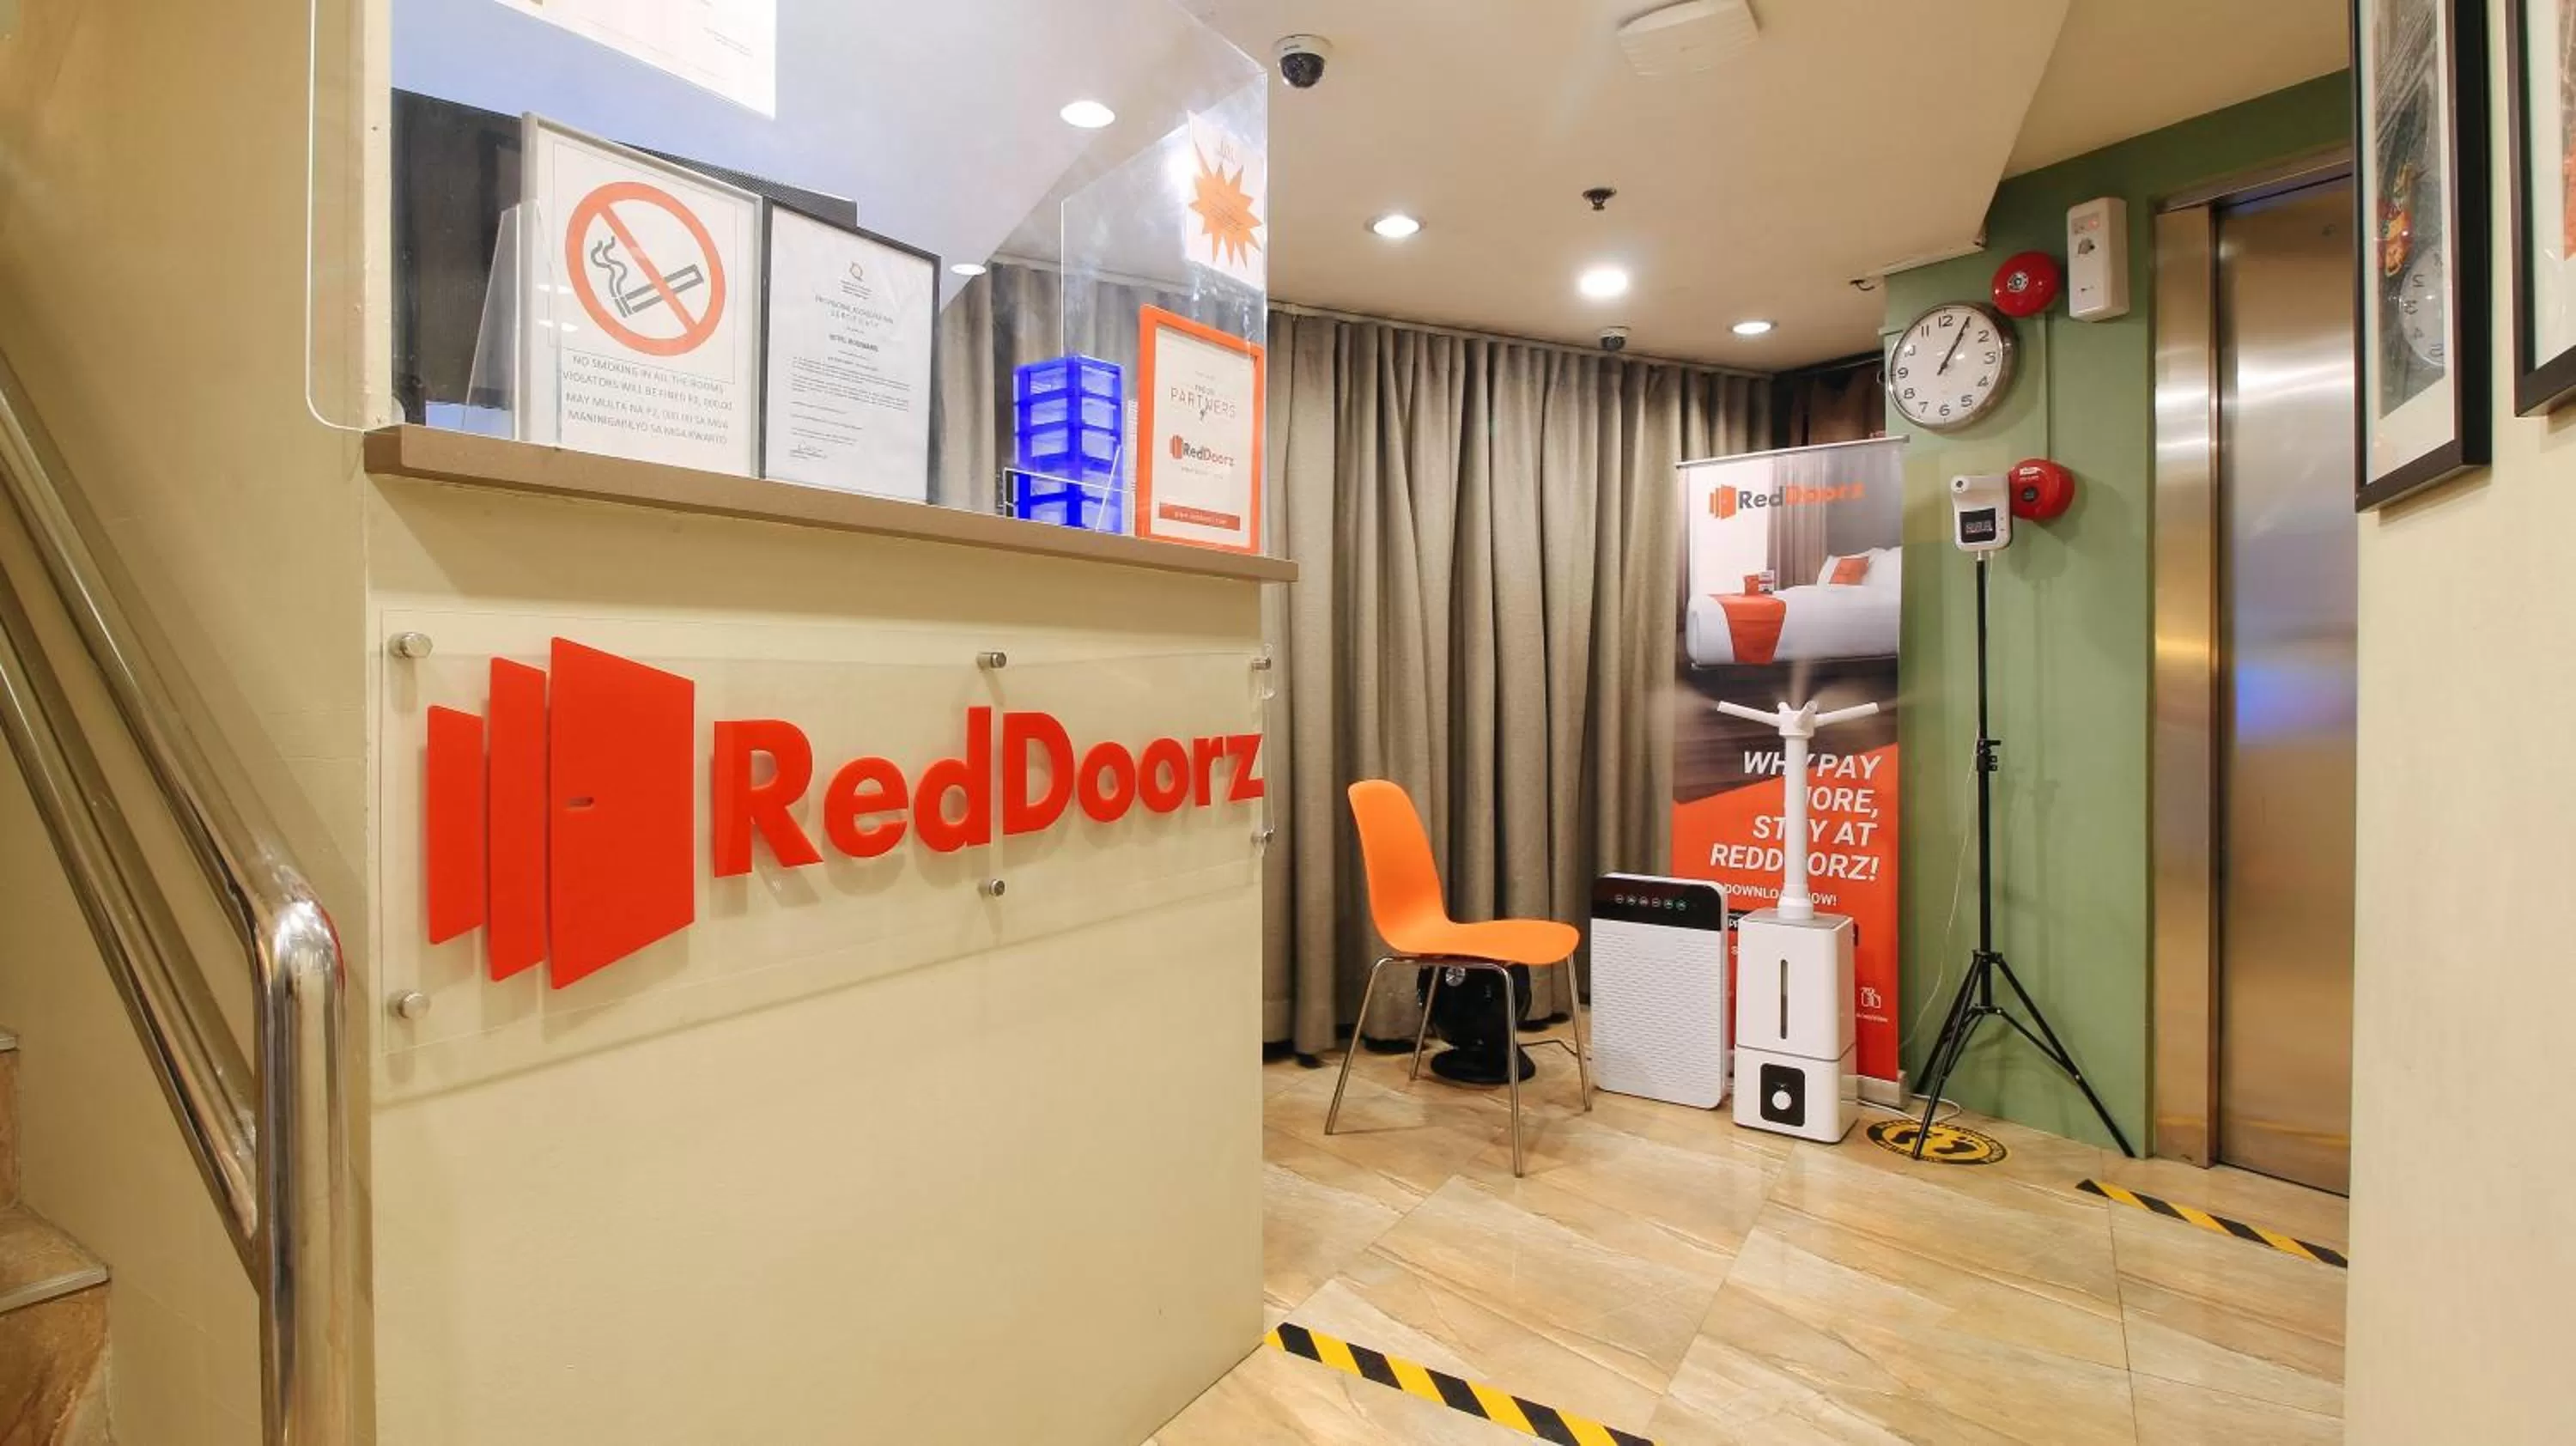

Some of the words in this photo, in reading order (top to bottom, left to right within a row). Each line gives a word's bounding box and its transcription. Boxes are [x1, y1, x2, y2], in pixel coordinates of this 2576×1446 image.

[1921, 325, 1929, 337] 11
[1938, 314, 1953, 328] 12
[1978, 330, 1990, 343] 2
[1984, 351, 1996, 364] 3
[572, 355, 590, 368] NO
[592, 359, 638, 378] SMOKING
[641, 370, 652, 380] IN
[653, 373, 667, 383] ALL
[672, 375, 688, 386] THE
[1897, 367, 1909, 379] 9
[1978, 376, 1990, 386] 4
[563, 371, 619, 389] VIOLATORS
[621, 382, 642, 394] WILL
[645, 386, 657, 397] BE
[1904, 387, 1916, 399] 8
[566, 392, 590, 404] MAY
[592, 398, 628, 410] MULTA
[629, 404, 644, 413] NA
[1170, 386, 1236, 419] PARTNERS
[1918, 401, 1929, 413] 7
[1939, 404, 1951, 416] 6
[1960, 394, 1972, 407] 5
[1182, 441, 1236, 468] RedDoorz
[1739, 483, 1867, 509] RedDoorz
[1816, 753, 1883, 780] PAY
[714, 706, 1264, 878] RedDoorz
[1806, 786, 1879, 818] ORE,
[1753, 816, 1828, 843] STY
[1832, 821, 1879, 847] AT
[1710, 842, 1880, 881] REDDORZ!
[1724, 884, 1783, 899] DOWNLO
[1807, 892, 1838, 906] OW!
